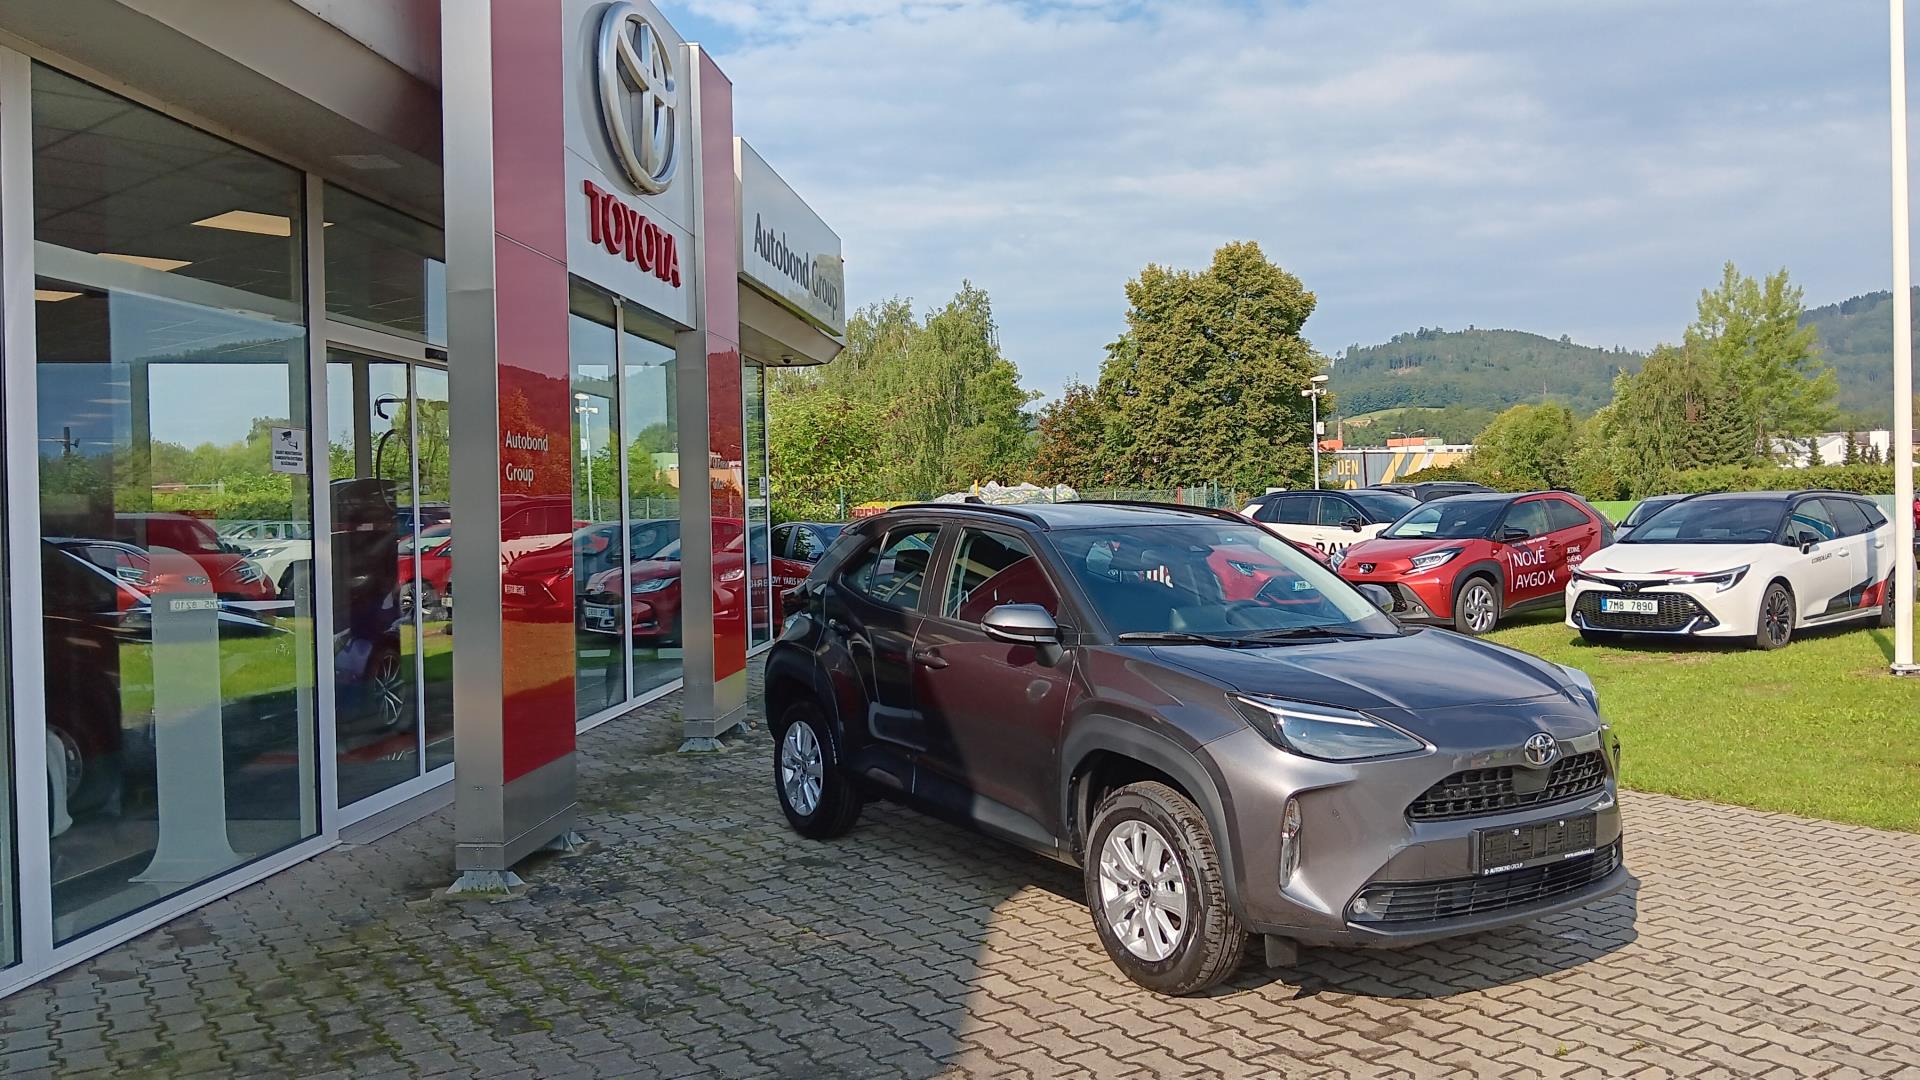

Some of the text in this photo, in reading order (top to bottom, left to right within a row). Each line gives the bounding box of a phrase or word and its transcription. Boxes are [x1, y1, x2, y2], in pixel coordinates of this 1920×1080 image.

[583, 179, 681, 288] TOYOTA
[754, 212, 838, 320] Autobond Group
[505, 430, 549, 452] Autobond
[505, 462, 534, 488] Group
[1513, 546, 1547, 568] NOVÉ
[1515, 569, 1556, 590] AYGO X
[1631, 601, 1653, 611] 7890
